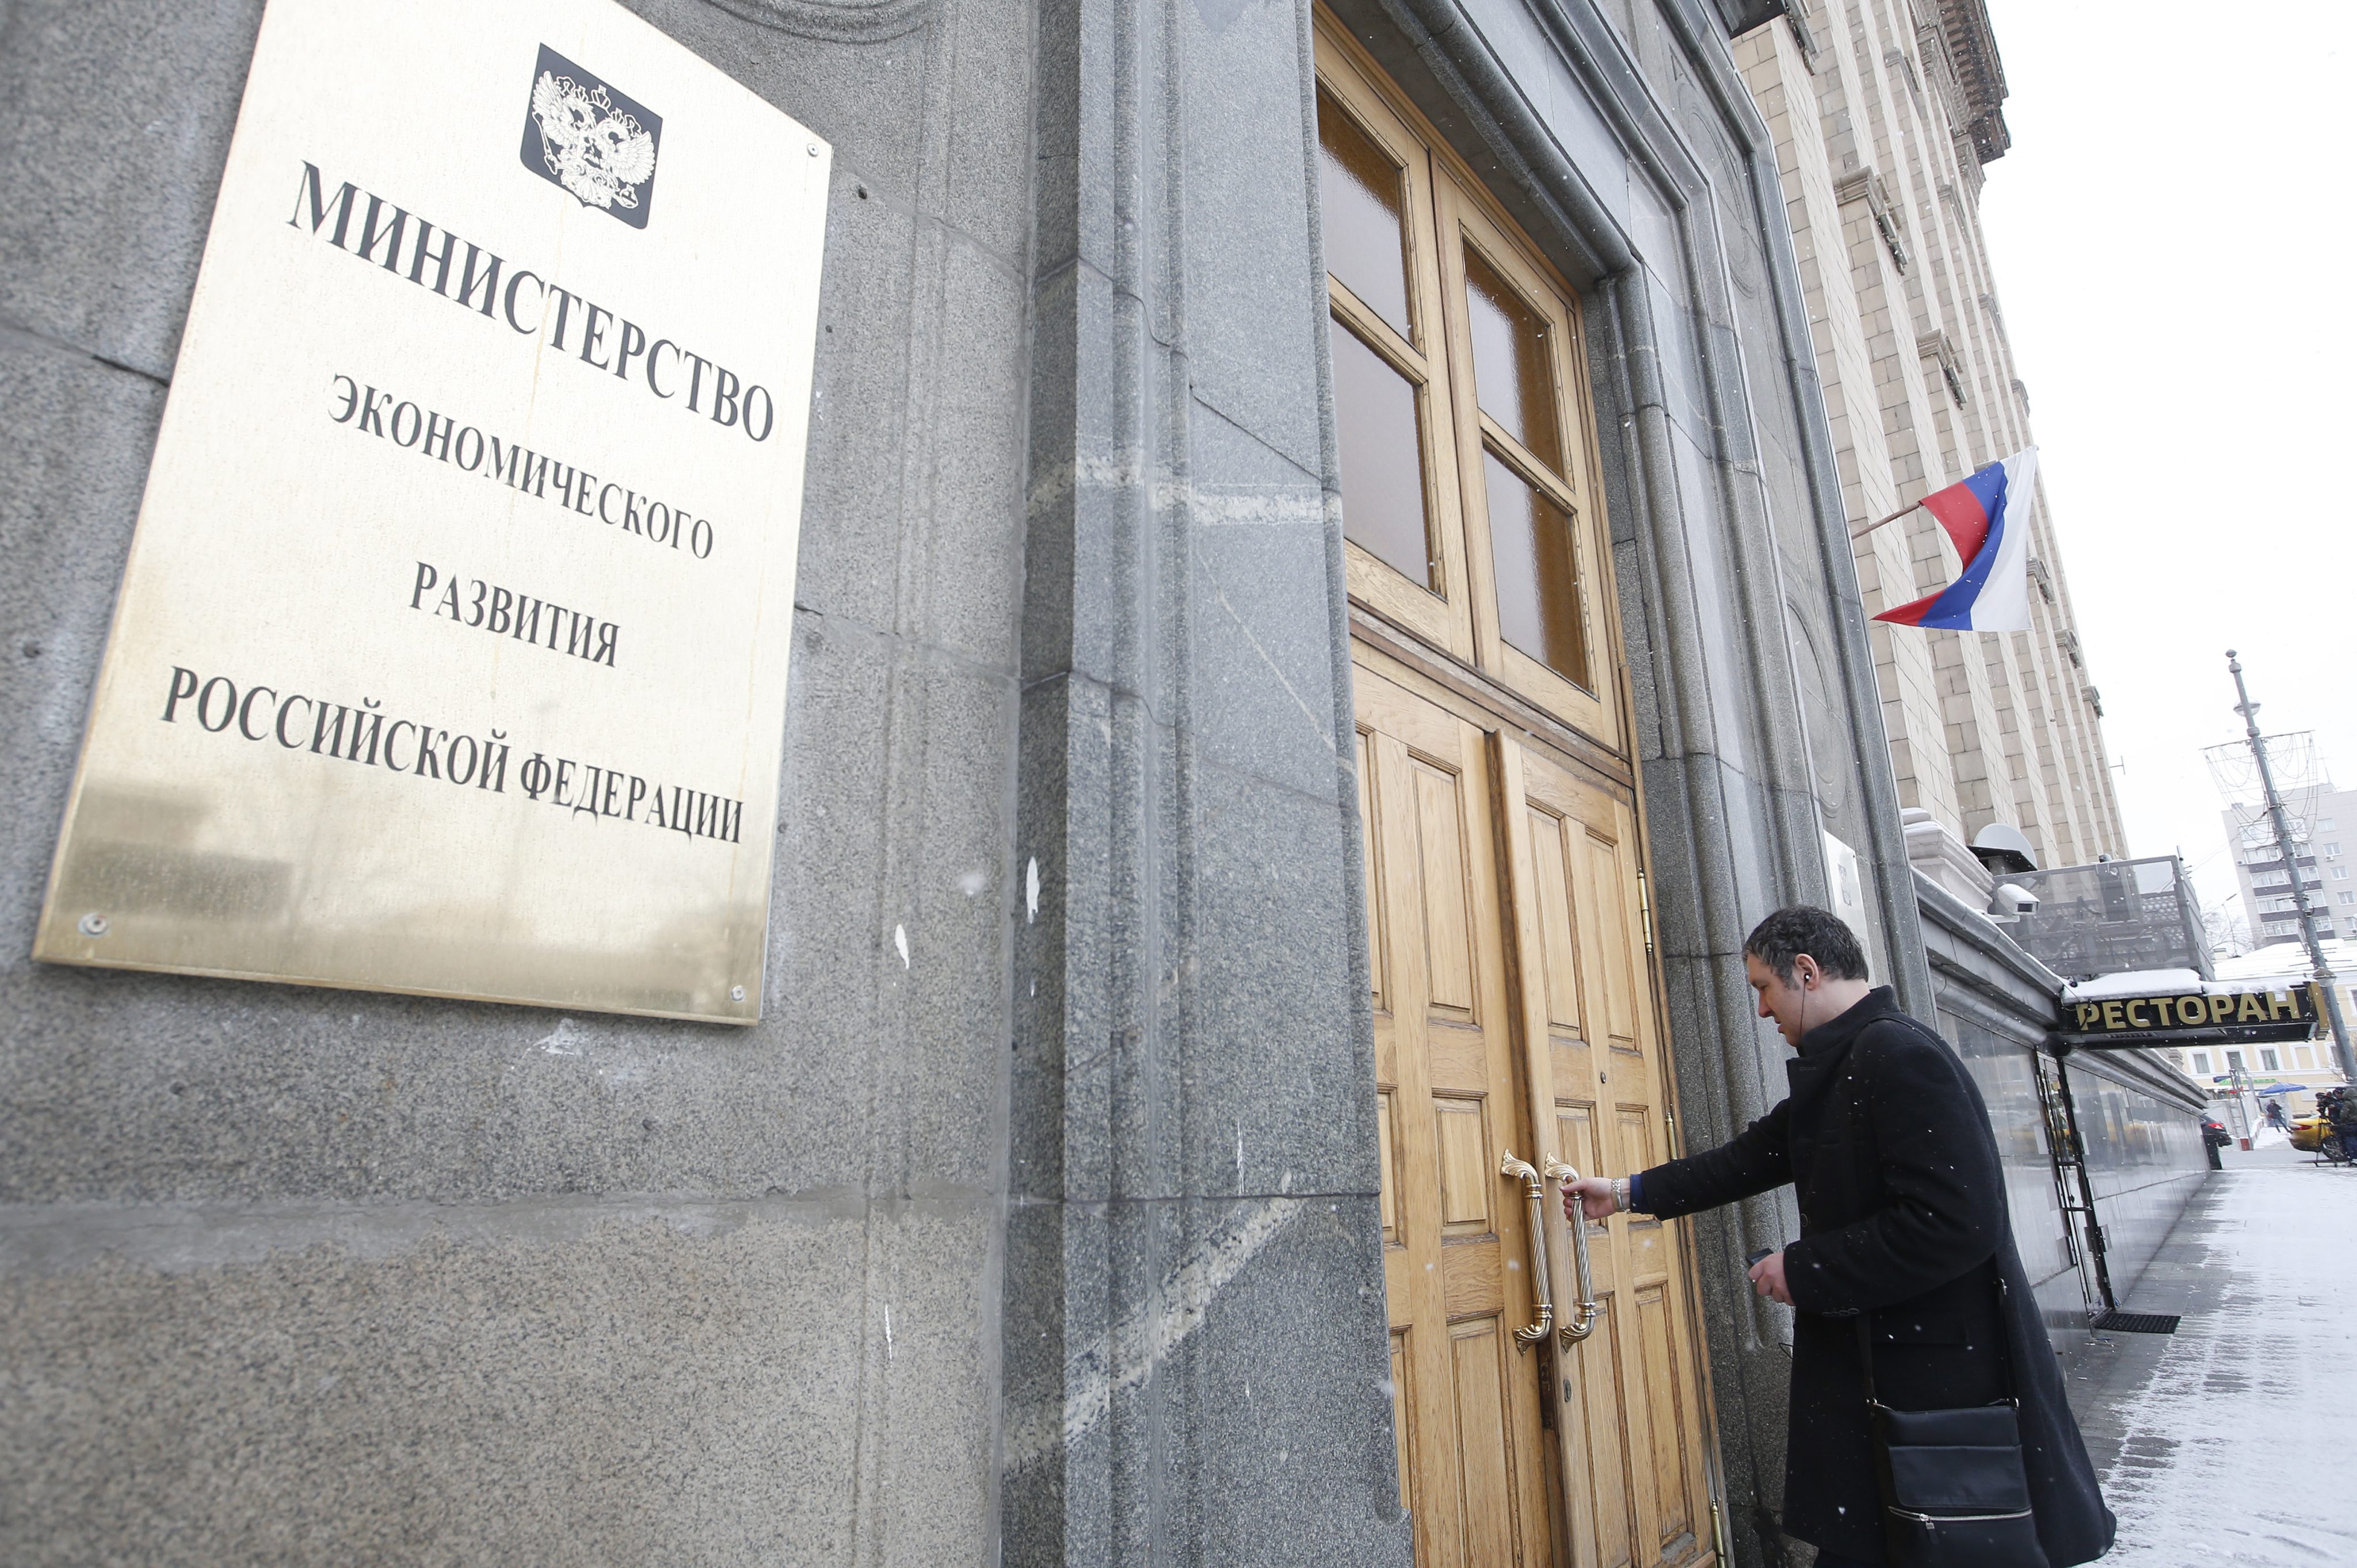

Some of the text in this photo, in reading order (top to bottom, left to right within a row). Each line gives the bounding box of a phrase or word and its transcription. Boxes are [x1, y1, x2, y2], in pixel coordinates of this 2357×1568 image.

[287, 161, 773, 442] МИНИСТЕРСТВО
[329, 373, 714, 559] ЭКОНОМИЧЕСКОГО
[409, 562, 620, 667] РАЗВИТИЯ
[161, 666, 743, 844] РОССИЙСКОЙ ФЕДЕРАЦИИ
[2076, 990, 2301, 1031] РЕСТОРАН
